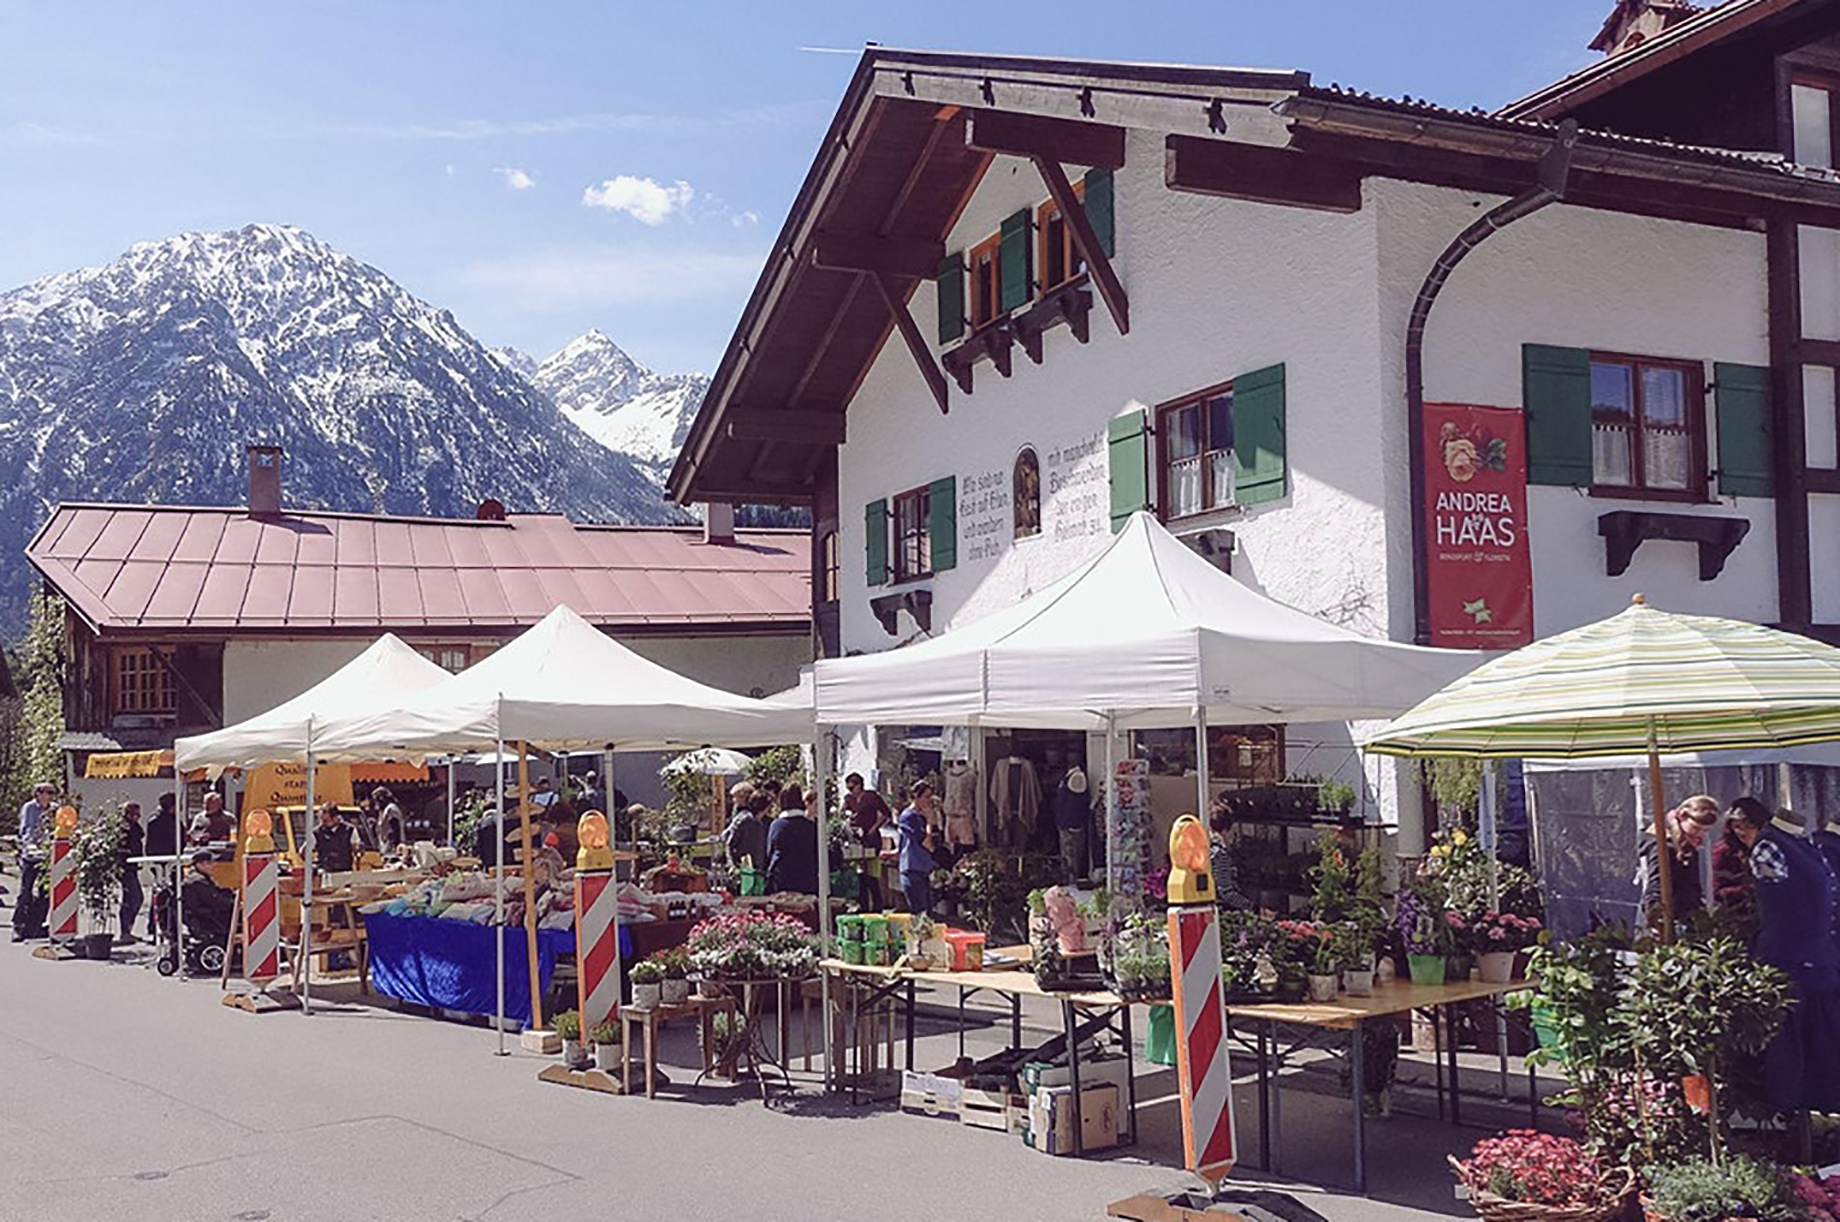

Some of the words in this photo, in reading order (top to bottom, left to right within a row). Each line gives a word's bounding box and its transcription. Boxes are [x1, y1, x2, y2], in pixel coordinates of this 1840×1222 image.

[1436, 492, 1513, 513] ANDREA
[1436, 515, 1515, 546] HAAS
[274, 764, 318, 776] Qualitt
